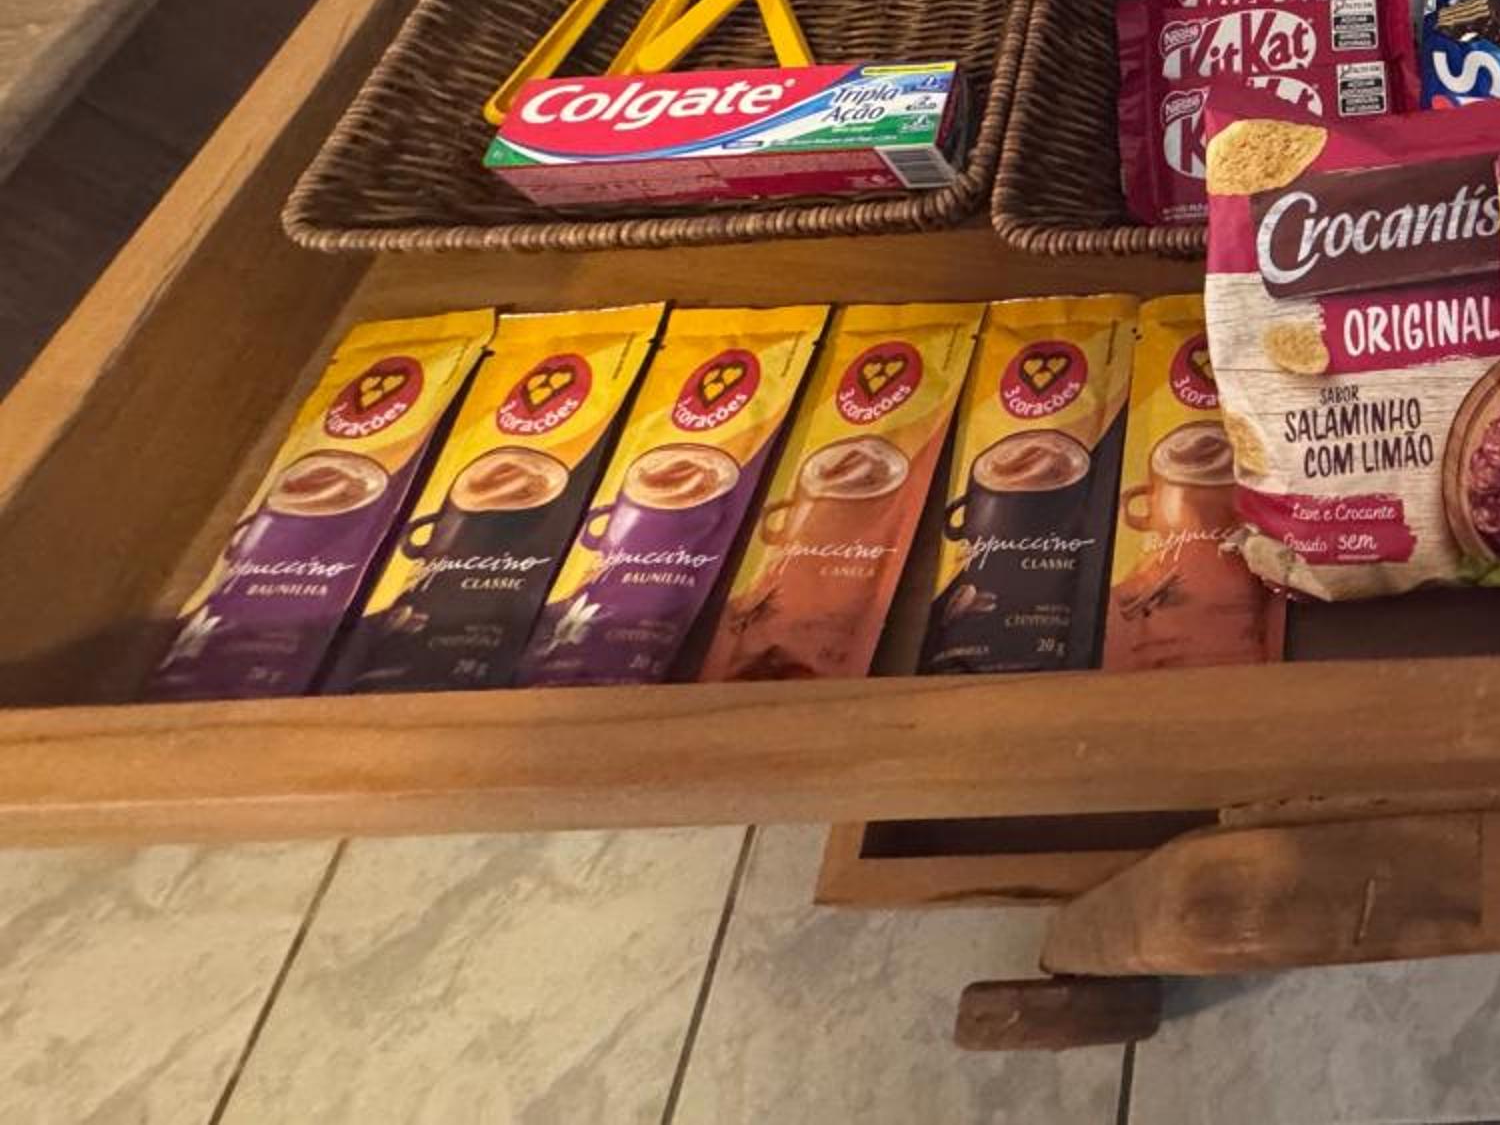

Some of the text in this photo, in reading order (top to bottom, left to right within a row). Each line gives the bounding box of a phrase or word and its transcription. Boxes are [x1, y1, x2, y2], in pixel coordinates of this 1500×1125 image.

[519, 82, 785, 131] Colgate
[832, 84, 899, 107] Tripla
[822, 104, 885, 125] Ação
[1344, 296, 1500, 357] ORIGINAL
[840, 385, 912, 421] corações
[1009, 381, 1082, 416] corações
[1320, 385, 1360, 405] SABOR
[500, 399, 579, 432] corações
[675, 392, 748, 427] corações
[1285, 398, 1422, 443] SALAMINHO
[1304, 430, 1434, 479] COM LIMÃO
[1293, 502, 1396, 521] Leve e Crocante
[1337, 533, 1378, 550] sem
[1021, 558, 1076, 571] CLASSIC
[461, 577, 527, 591] CLASSIC
[622, 572, 696, 588] BAUNILHA
